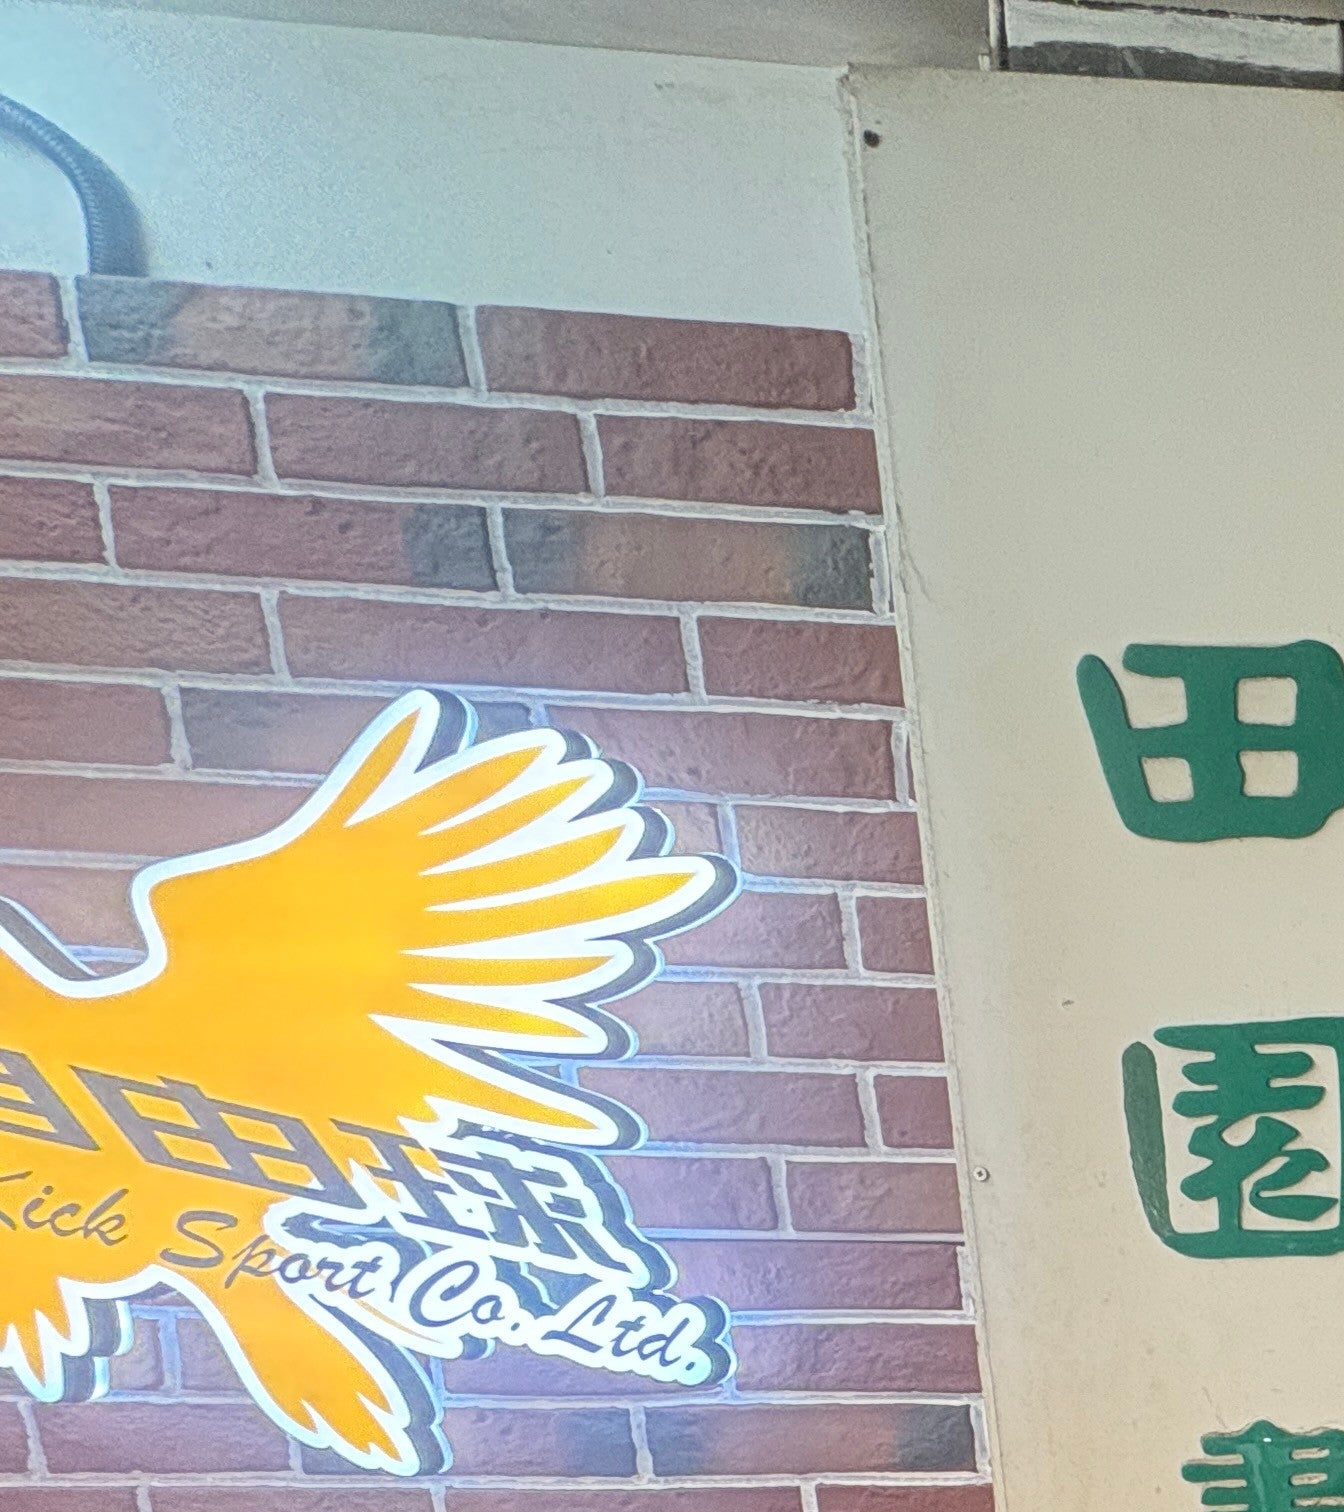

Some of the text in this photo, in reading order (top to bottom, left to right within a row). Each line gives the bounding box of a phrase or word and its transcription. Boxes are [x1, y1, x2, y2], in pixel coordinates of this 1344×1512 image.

[160, 1209, 384, 1299] Sport
[408, 1260, 522, 1333] Co.
[541, 1293, 697, 1372] Ltd.
